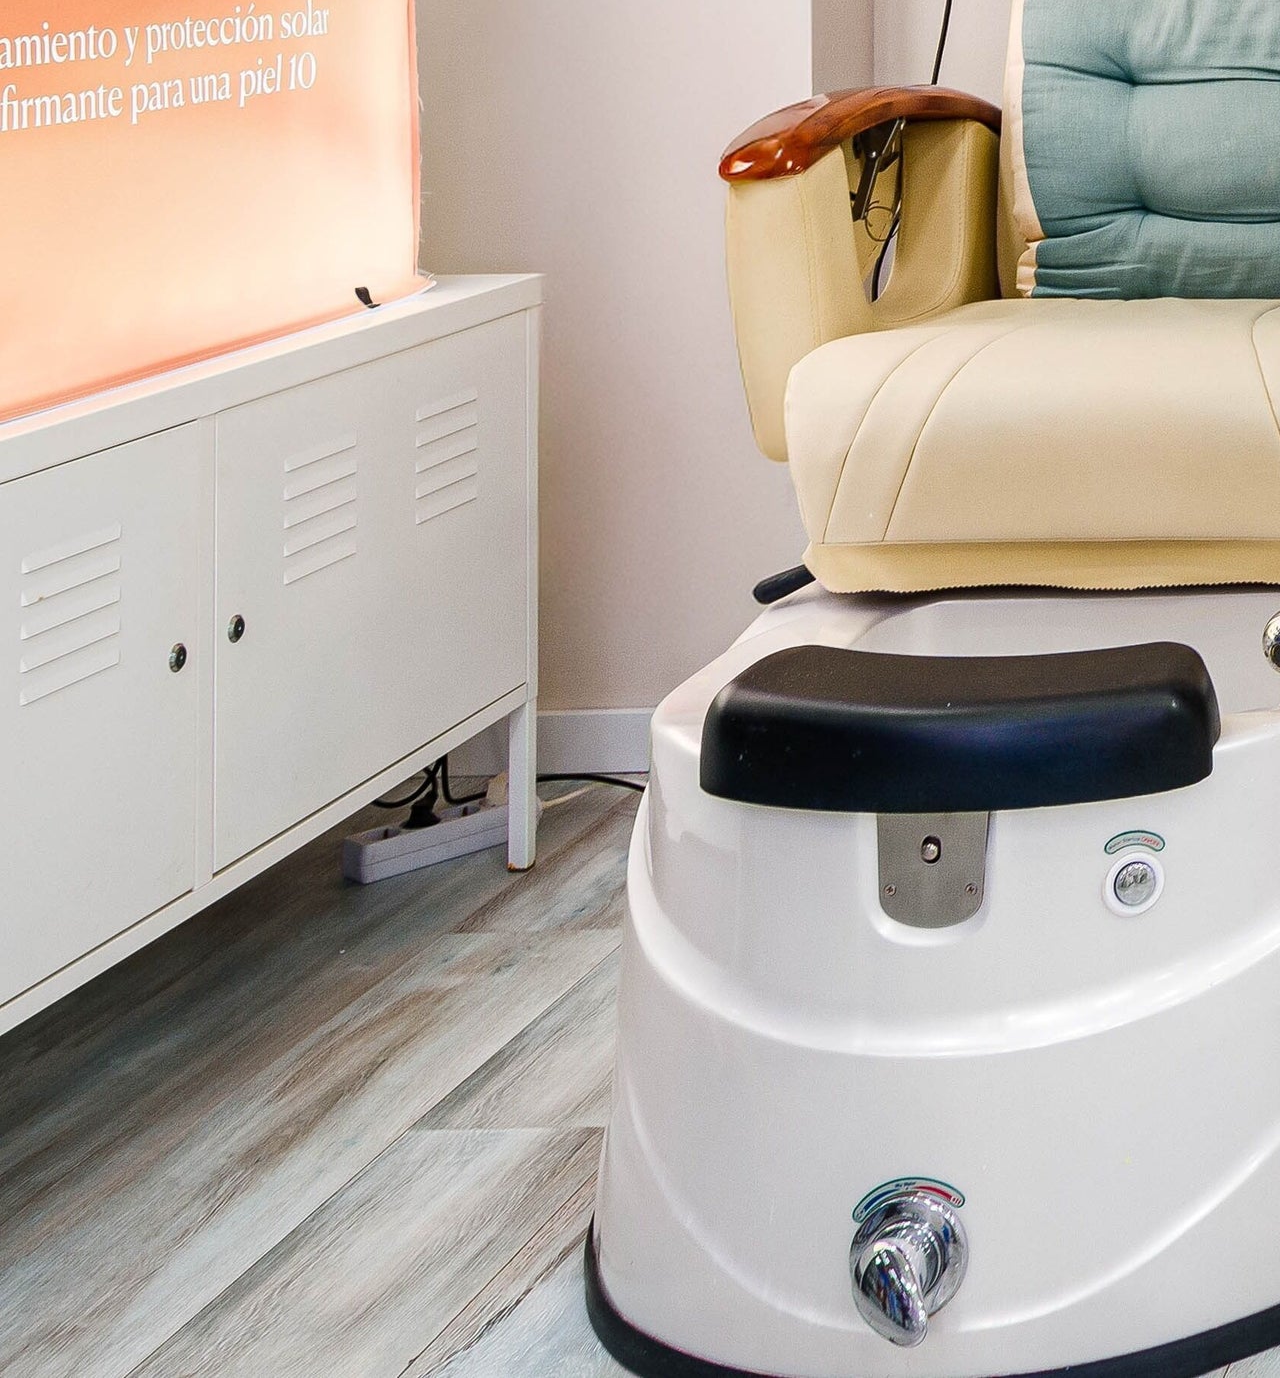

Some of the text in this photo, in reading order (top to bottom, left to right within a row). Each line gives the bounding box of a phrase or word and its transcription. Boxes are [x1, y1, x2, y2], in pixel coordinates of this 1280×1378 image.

[124, 25, 140, 67] y
[146, 3, 274, 64] protección
[0, 51, 317, 132] firmante para una piel 10
